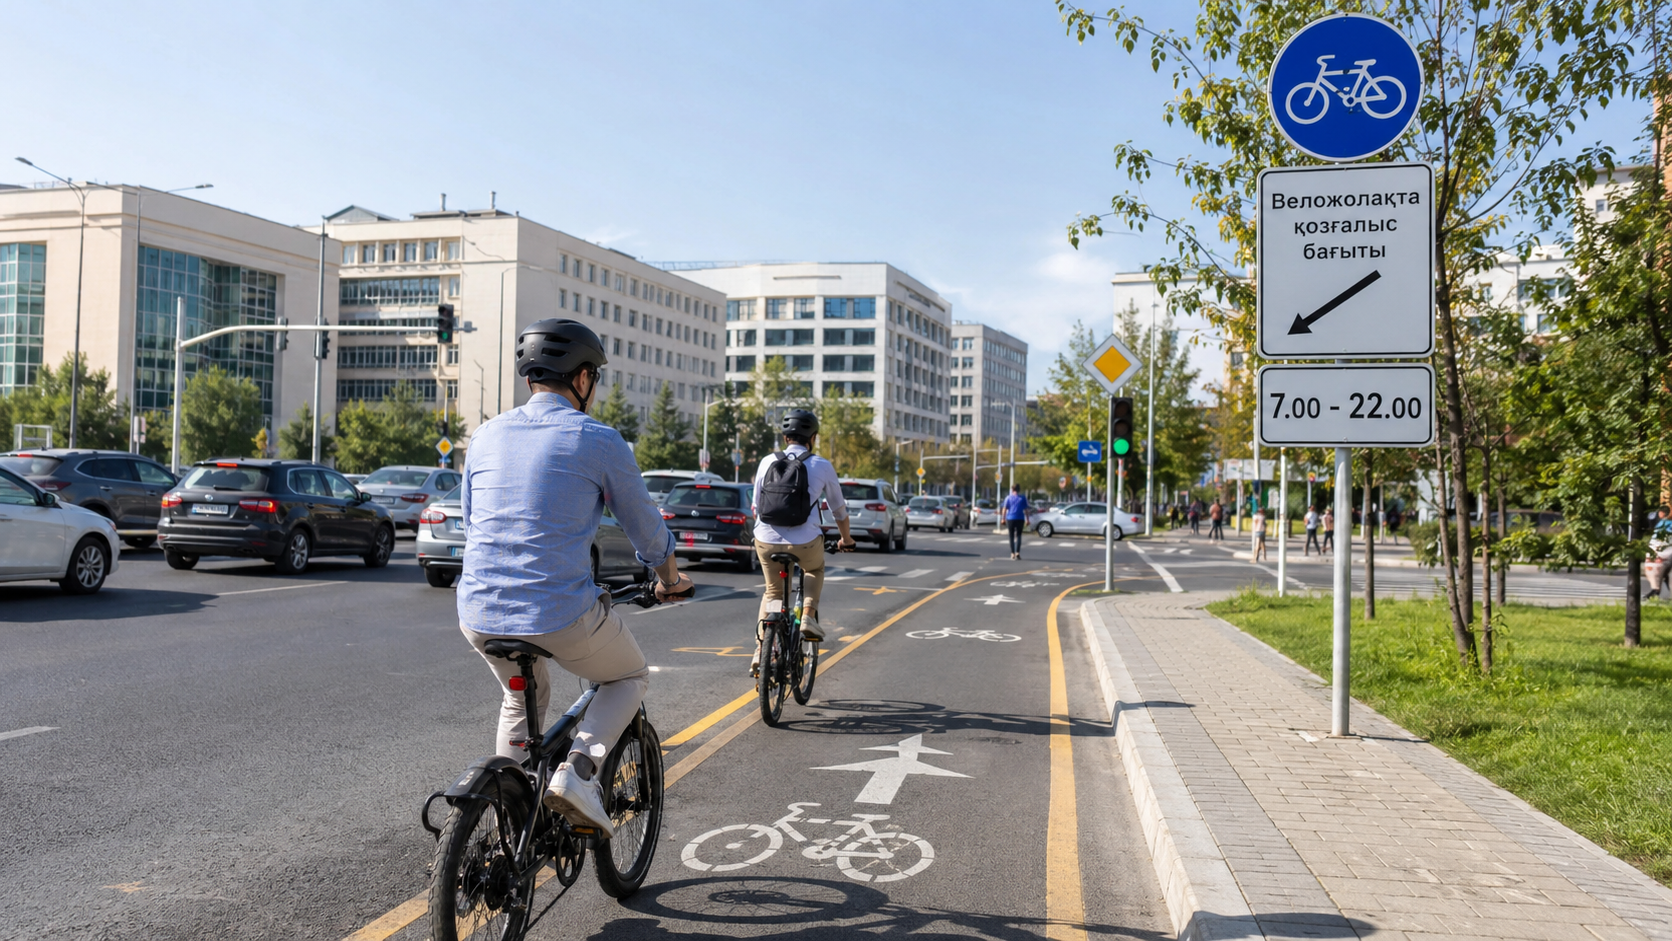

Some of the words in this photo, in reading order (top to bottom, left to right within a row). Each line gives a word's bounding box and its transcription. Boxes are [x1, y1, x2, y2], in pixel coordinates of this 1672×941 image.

[1272, 191, 1420, 210] Веложолақта
[1294, 218, 1398, 237] қозғалыс
[1303, 243, 1386, 260] бағыты
[1270, 393, 1321, 419] 7.00
[1349, 393, 1422, 419] 22.00
